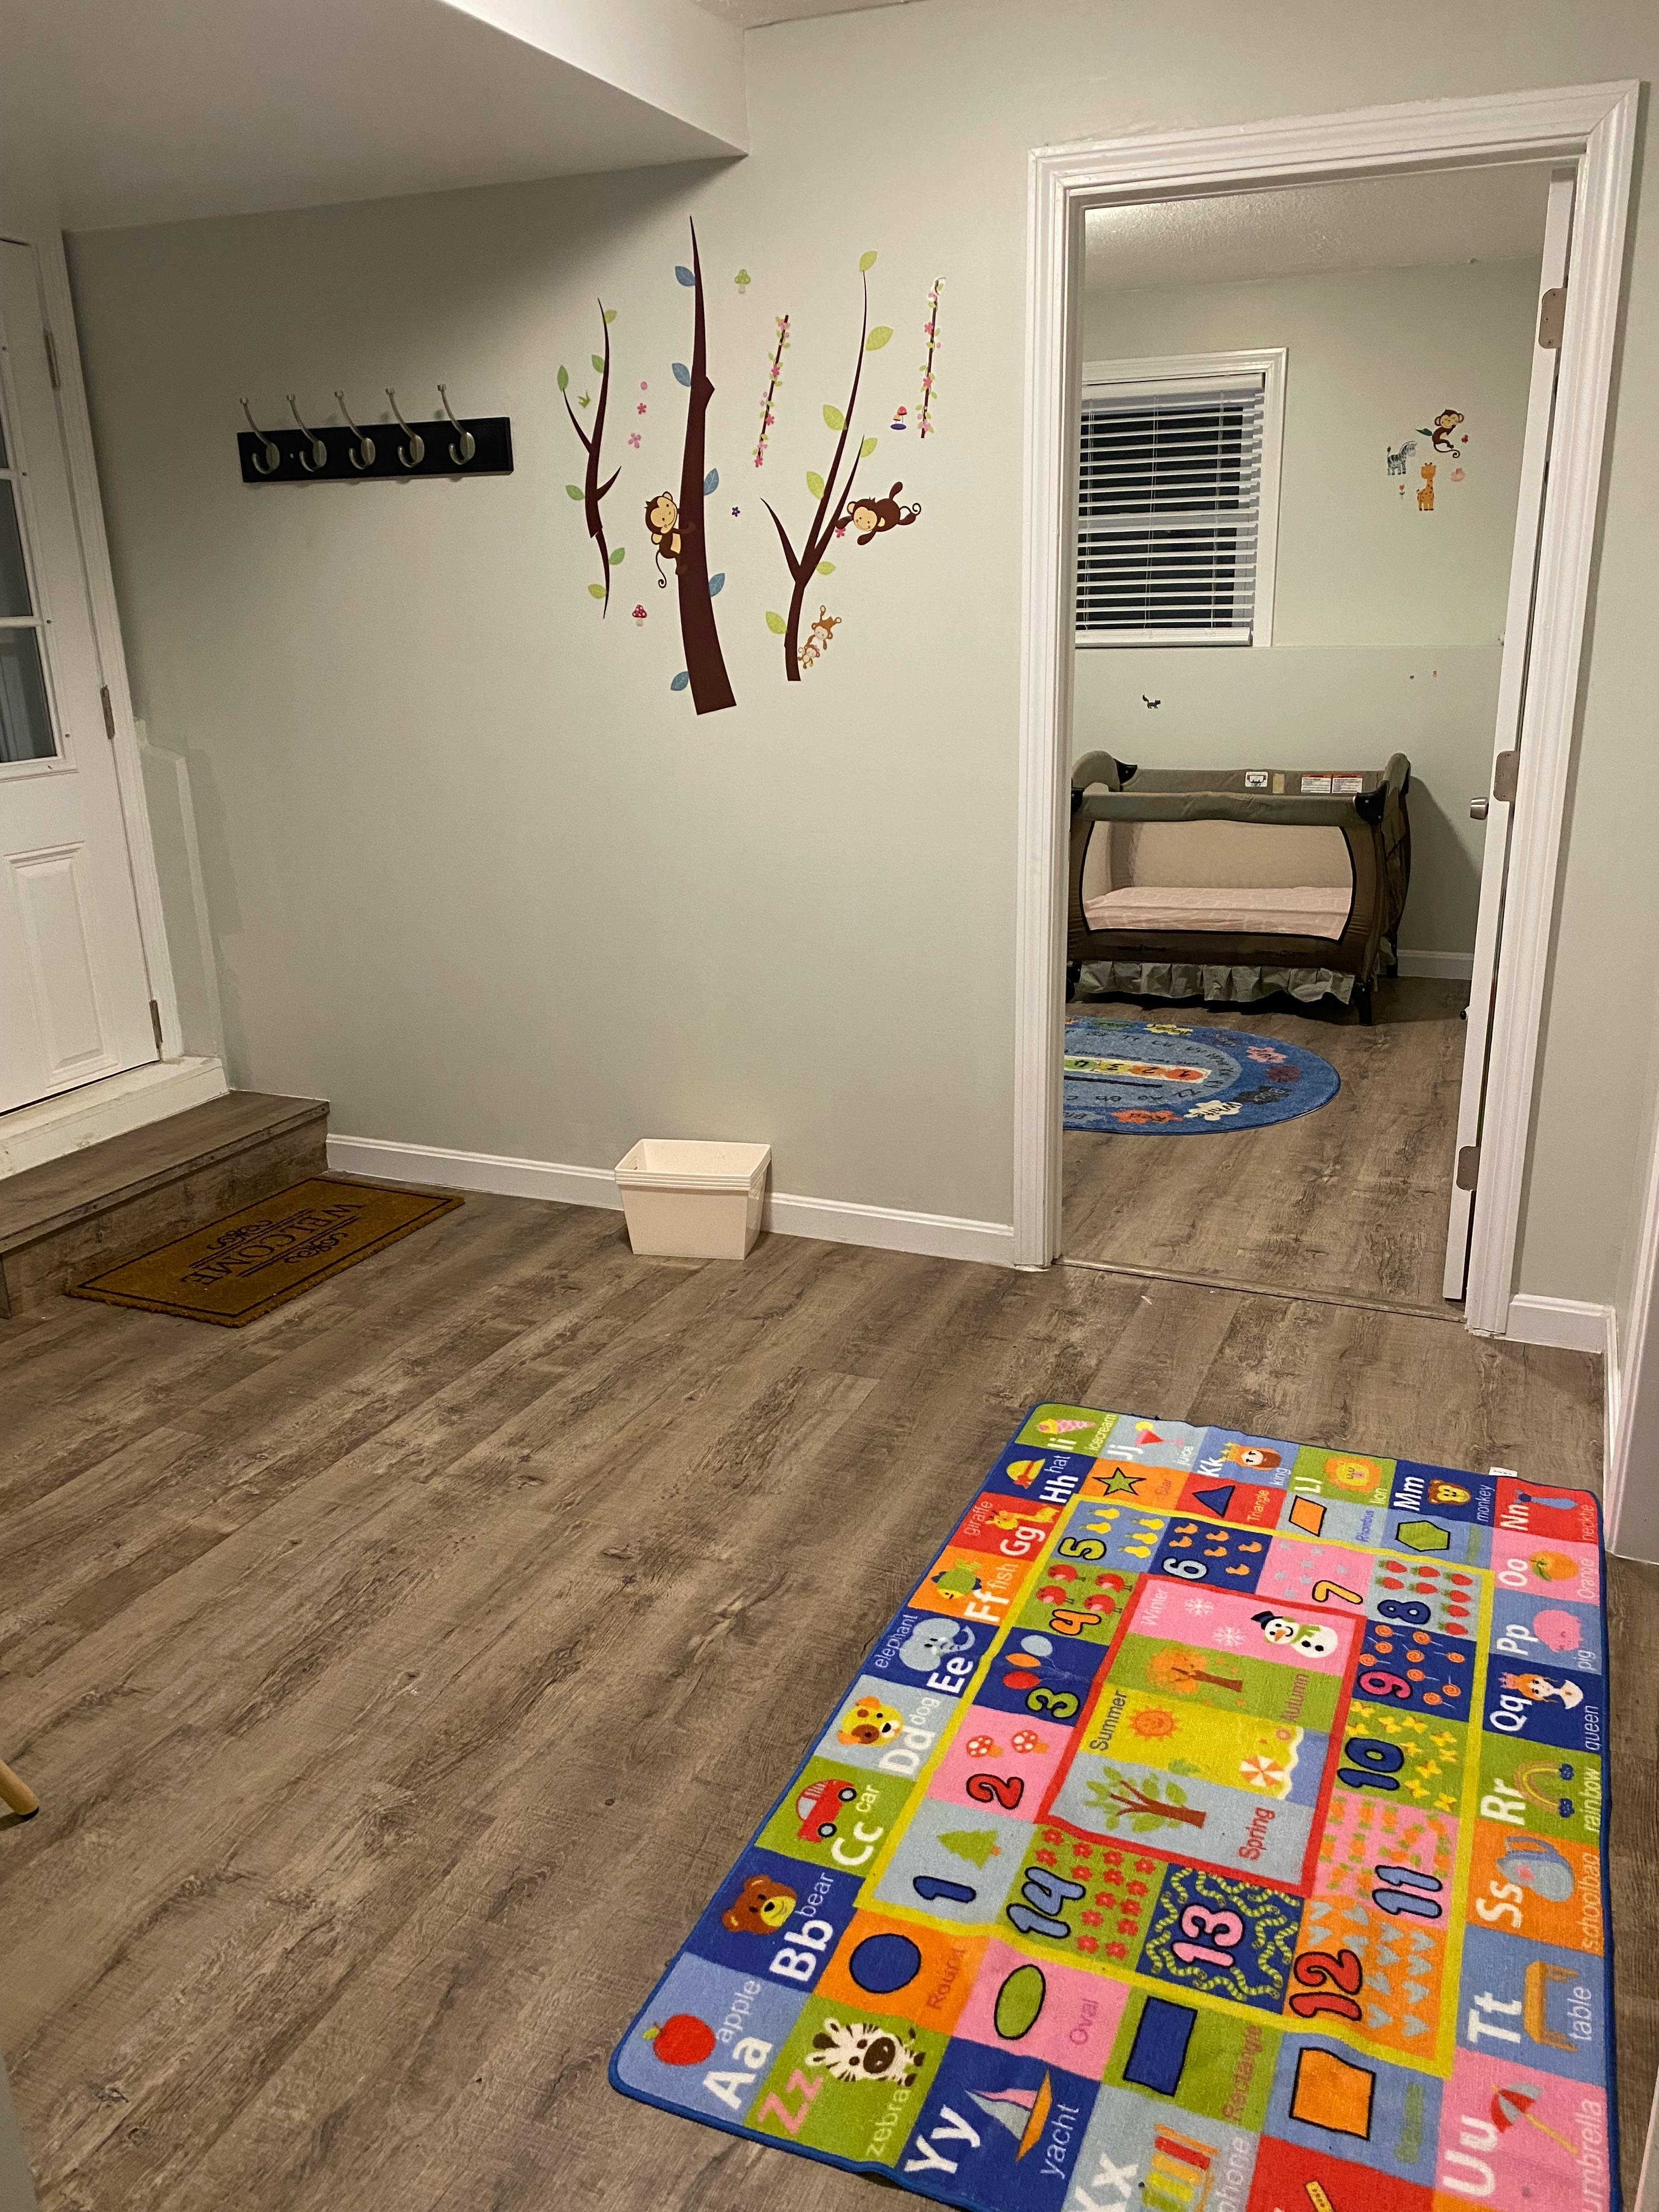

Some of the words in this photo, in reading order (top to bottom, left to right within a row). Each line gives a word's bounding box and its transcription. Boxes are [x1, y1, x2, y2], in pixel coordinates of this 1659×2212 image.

[1074, 1059, 1090, 1068] 4
[1106, 1063, 1124, 1071] 3
[180, 1204, 365, 1286] WELCOME
[1046, 1437, 1077, 1451] Ii
[1107, 1444, 1144, 1461] Jj
[1173, 1445, 1194, 1467] juice
[1044, 1455, 1071, 1474] hat
[1197, 1456, 1226, 1477] Kk
[1272, 1466, 1291, 1486] king
[1039, 1474, 1079, 1504] Hh
[1393, 1476, 1425, 1511] Mm
[1476, 1484, 1496, 1523] monkey
[963, 1500, 993, 1537] giraffe
[1500, 1504, 1530, 1531] Nn
[1582, 1504, 1595, 1542] necktie
[999, 1526, 1046, 1556] Gg
[1058, 1537, 1107, 1560] 5
[988, 1562, 1019, 1590] fish
[1161, 1556, 1208, 1580] 6
[1498, 1558, 1528, 1587] Oo
[1577, 1557, 1595, 1600] Orange
[963, 1589, 1010, 1623] Ff
[1140, 1588, 1169, 1627] Winter
[1312, 1579, 1363, 1605] 7
[1049, 1609, 1102, 1637] 4
[1377, 1599, 1431, 1625] 8
[874, 1613, 918, 1669] elephant
[1496, 1623, 1540, 1656] Pp
[926, 1656, 974, 1694] Ee
[1577, 1649, 1596, 1672] pig
[1025, 1686, 1081, 1719] 3
[1357, 1669, 1413, 1700] 9
[907, 1696, 942, 1726] dog
[1088, 1689, 1128, 1752] Summer
[1489, 1694, 1533, 1732] Qq
[1584, 1705, 1602, 1751] queen
[878, 1725, 935, 1775] Dd
[1336, 1737, 1405, 1791] 10
[855, 1784, 881, 1813] car
[966, 1773, 1025, 1810] 2
[1480, 1778, 1528, 1826] Rr
[1577, 1766, 1601, 1833] rainbow
[831, 1820, 884, 1866] Cc
[1238, 1805, 1276, 1862] Spring
[794, 1871, 834, 1918] bear
[912, 1874, 977, 1904] 1
[1006, 1865, 1086, 1939] 14
[1372, 1864, 1443, 1920] 11
[1475, 1880, 1523, 1930] Ss
[1577, 1852, 1600, 1951] schoolbag
[769, 1919, 834, 1982] Bb
[1170, 1904, 1246, 1969] 13
[1289, 1948, 1364, 2022] 12
[715, 1979, 762, 2044] apple
[1069, 1997, 1098, 2046] Oval
[1466, 1990, 1523, 2044] Tt
[1566, 1985, 1592, 2041] table
[702, 2036, 774, 2111] Aa
[757, 2068, 825, 2136] Zz
[865, 2087, 913, 2158] zebra
[903, 2103, 981, 2175] Yy
[1040, 2103, 1080, 2180] yacht
[1442, 2114, 1500, 2198] Uu
[1574, 2098, 1604, 2212] umbrella
